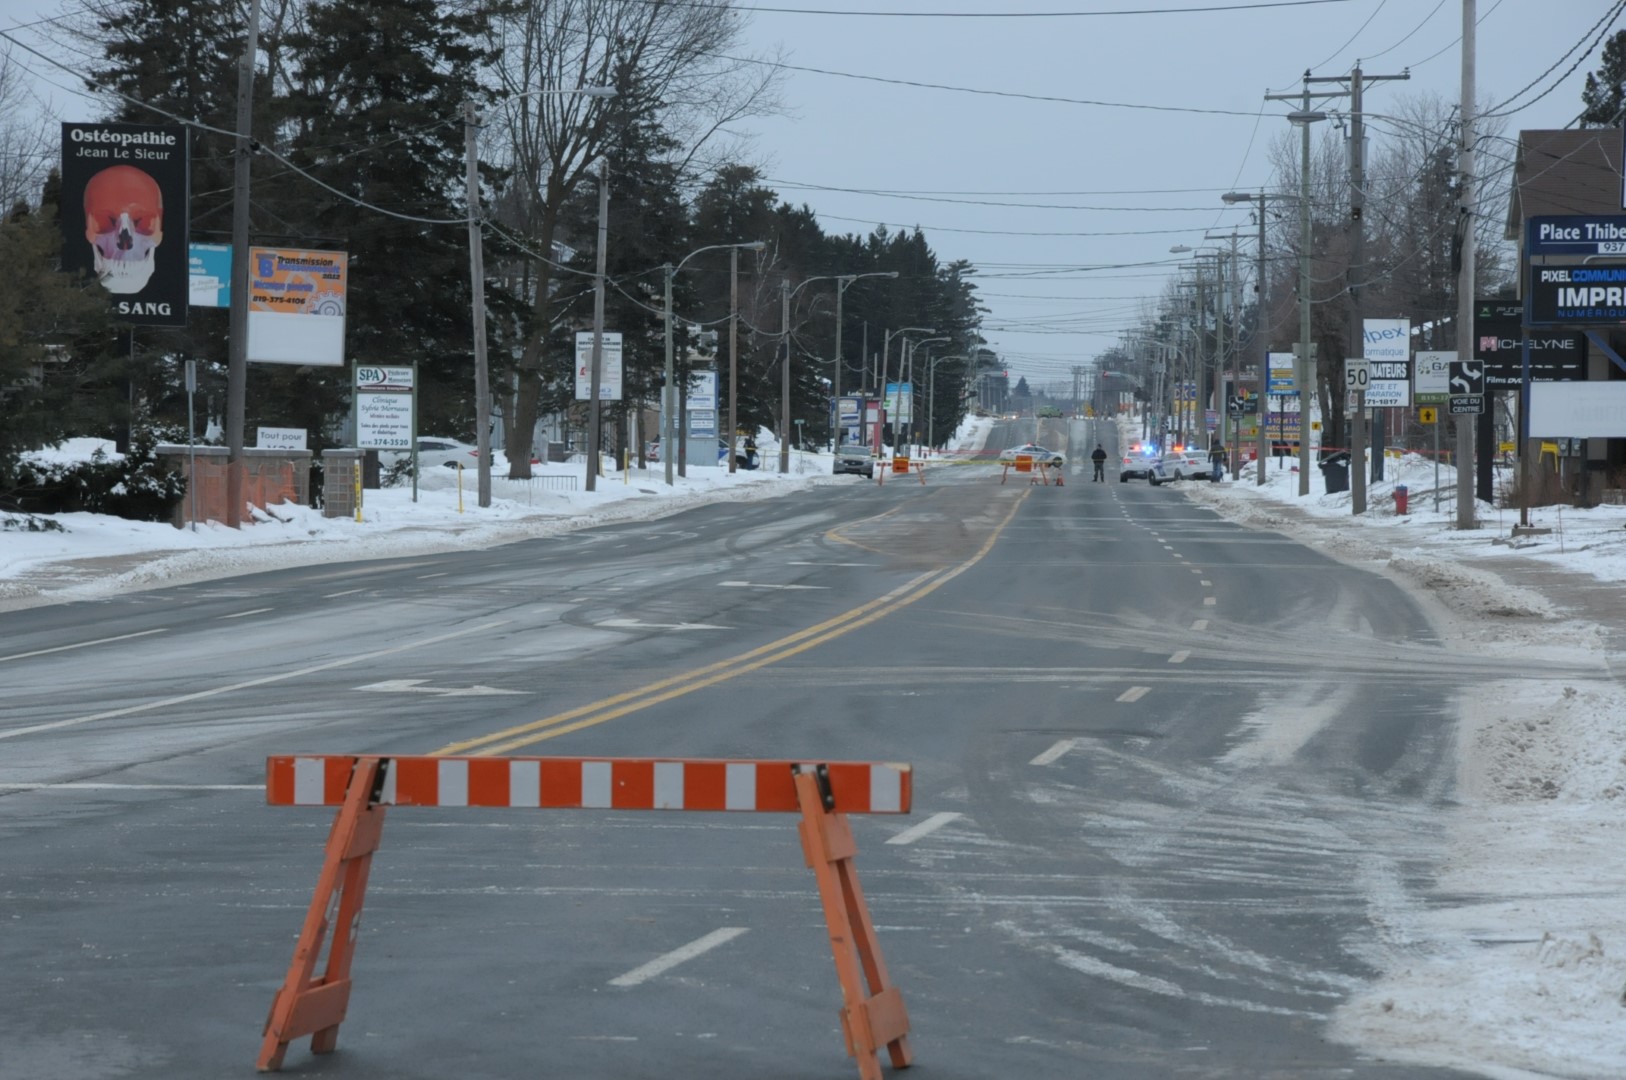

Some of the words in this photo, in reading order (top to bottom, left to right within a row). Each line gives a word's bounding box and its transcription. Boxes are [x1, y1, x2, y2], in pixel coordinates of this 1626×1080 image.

[70, 128, 176, 147] Ostéopathie
[76, 146, 109, 159] Jean
[113, 147, 130, 159] Le
[134, 148, 171, 160] Sieur
[1539, 223, 1581, 240] Place
[1603, 242, 1625, 252] 937
[277, 255, 334, 267] Transmission
[1541, 270, 1572, 283] PIXEL
[252, 295, 306, 305] 819-375-4106
[118, 301, 171, 316] SANG
[1479, 336, 1575, 352] MICHELYNE
[359, 368, 380, 381] SPA
[1347, 368, 1368, 386] 50
[1486, 375, 1506, 384] Films
[261, 432, 280, 440] Tout
[374, 438, 409, 447] 374-3520
